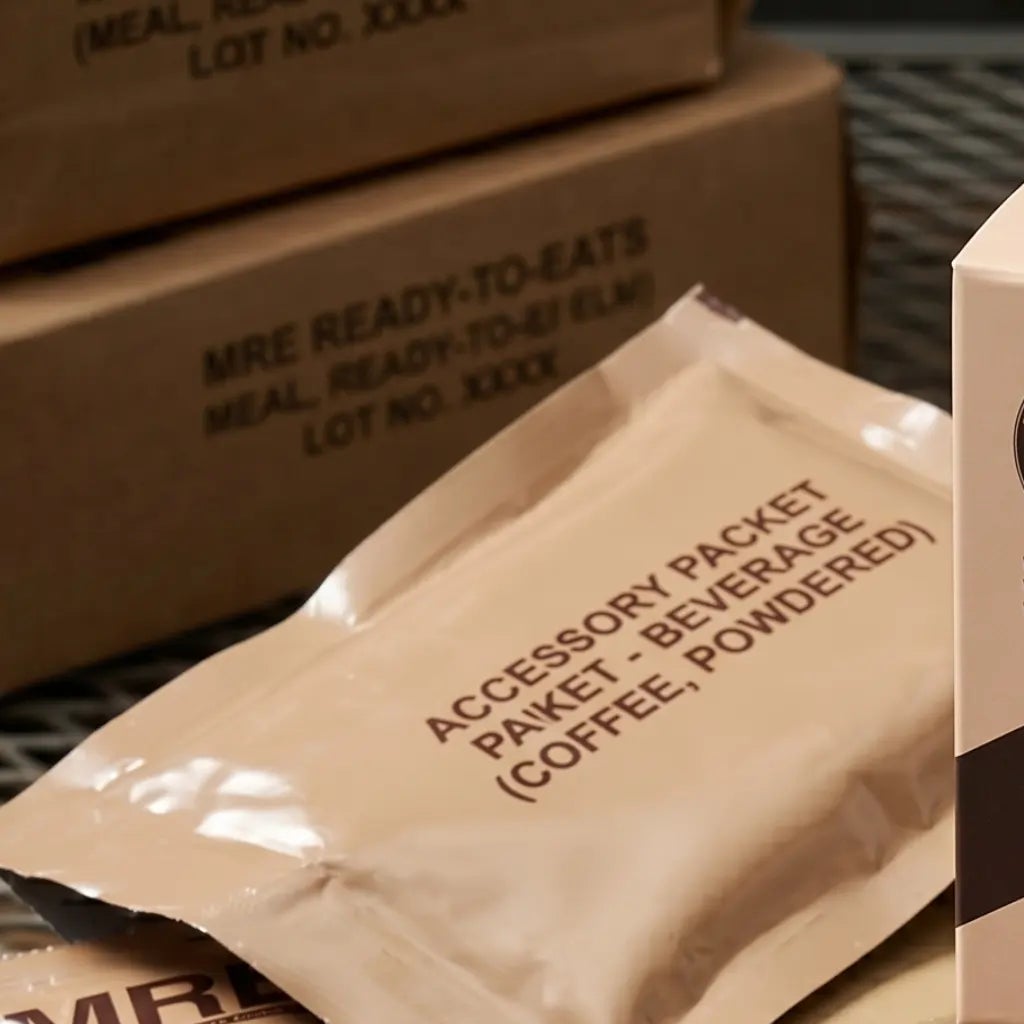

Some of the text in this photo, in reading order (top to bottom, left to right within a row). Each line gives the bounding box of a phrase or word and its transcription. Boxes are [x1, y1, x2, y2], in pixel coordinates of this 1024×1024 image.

[187, 28, 268, 79] LOT
[202, 321, 298, 385] MRE
[301, 402, 375, 458] LOT
[424, 478, 832, 744] ACCESSORY PACKET
[638, 507, 866, 651] BEVERAGE
[494, 517, 937, 804] (COFFEE, POWDERED)
